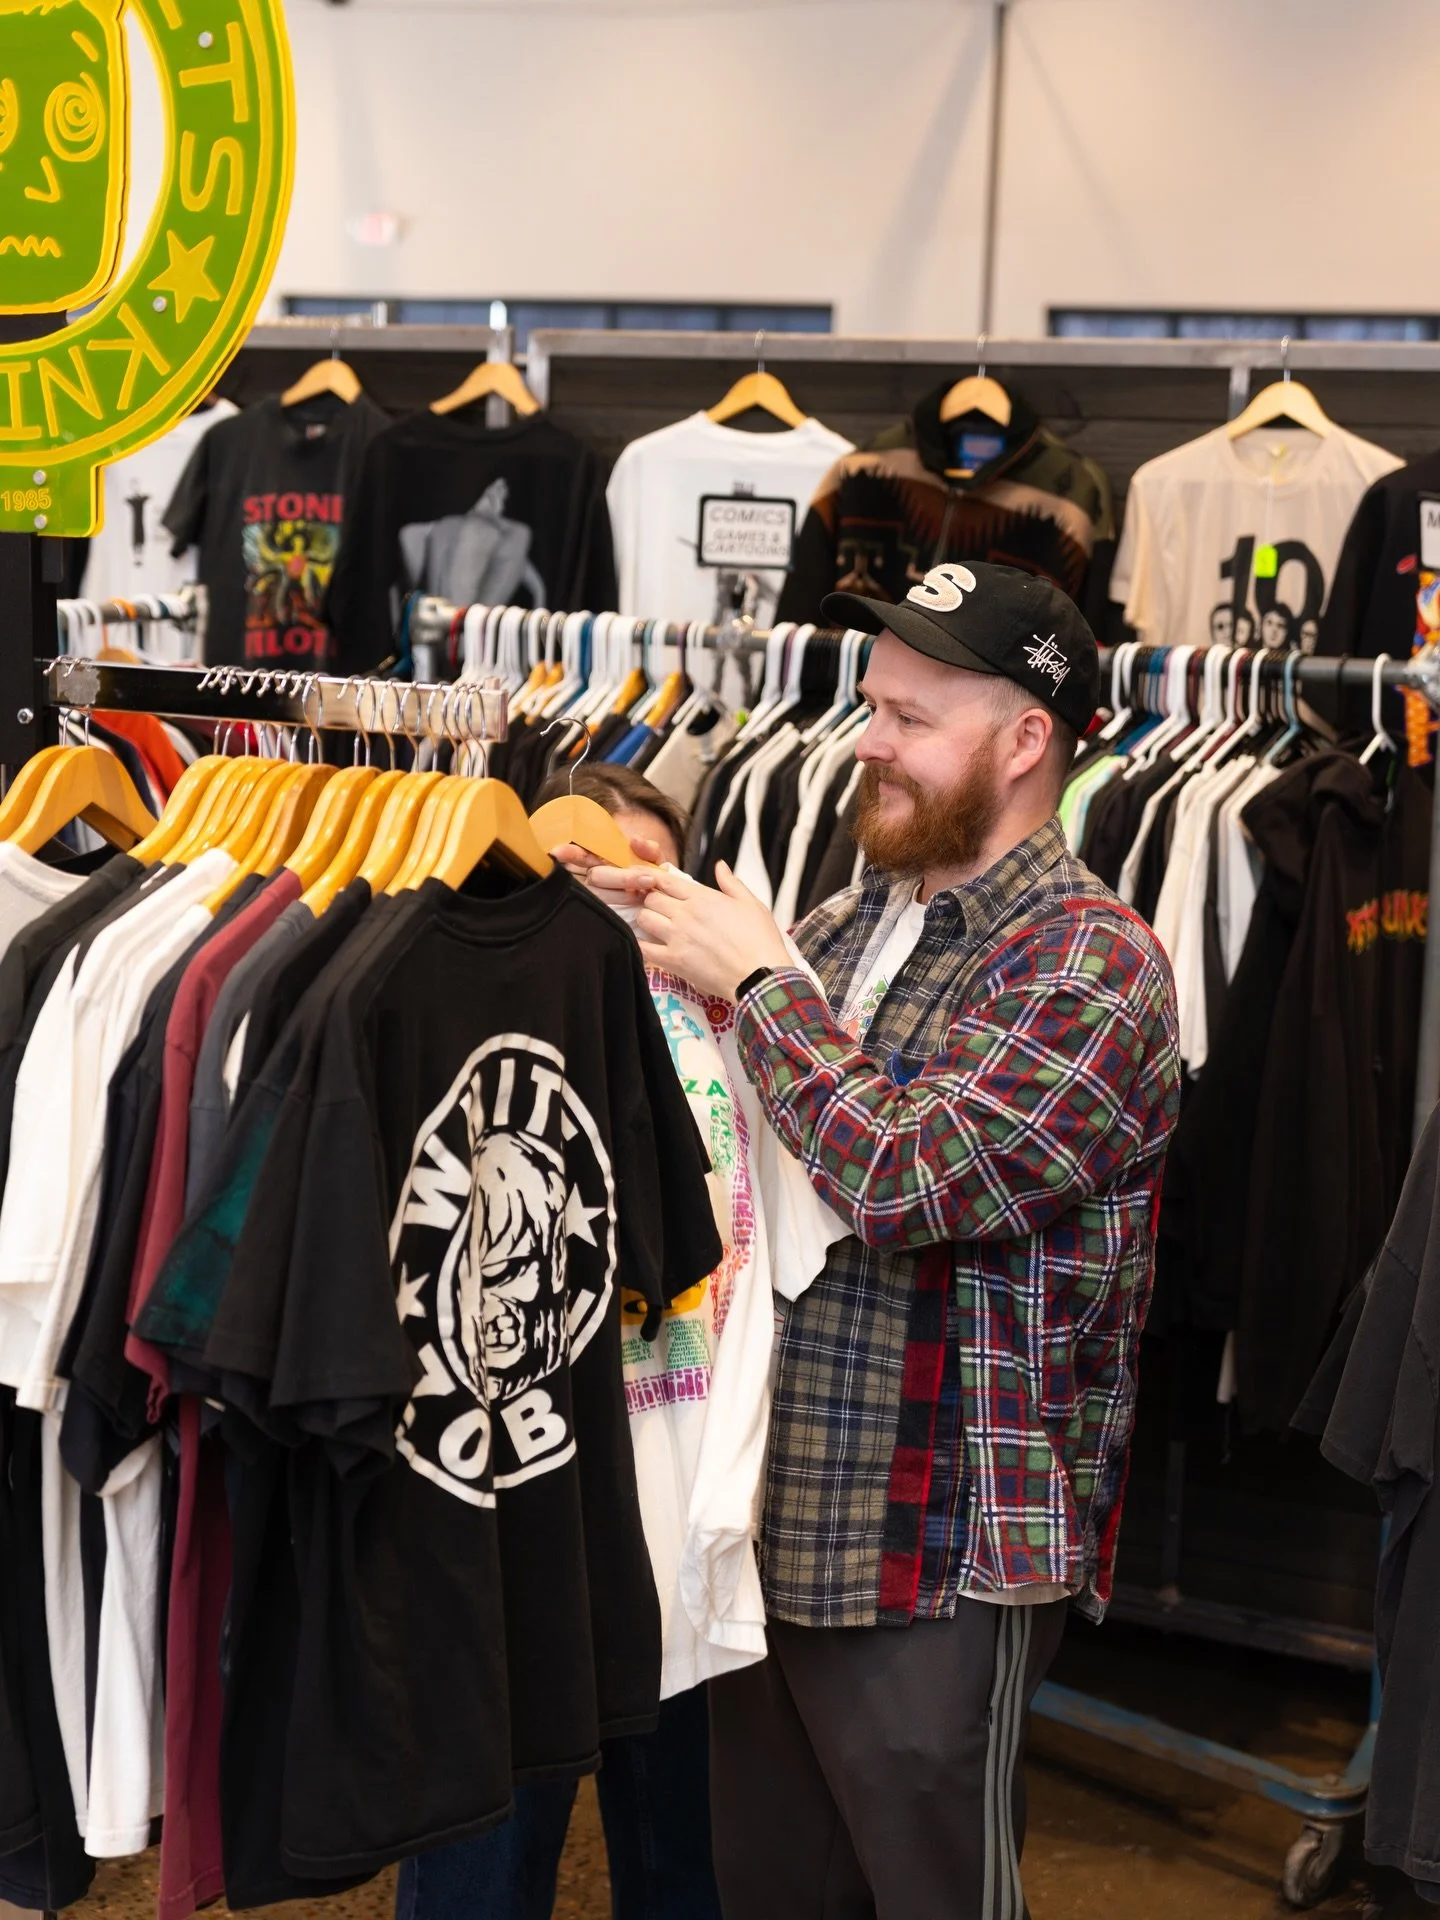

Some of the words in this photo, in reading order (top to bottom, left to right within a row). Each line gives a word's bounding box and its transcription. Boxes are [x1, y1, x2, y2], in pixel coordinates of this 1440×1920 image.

[1, 488, 52, 512] 1985
[709, 506, 787, 526] COMICS
[907, 563, 977, 612] S
[1219, 535, 1325, 622] 10
